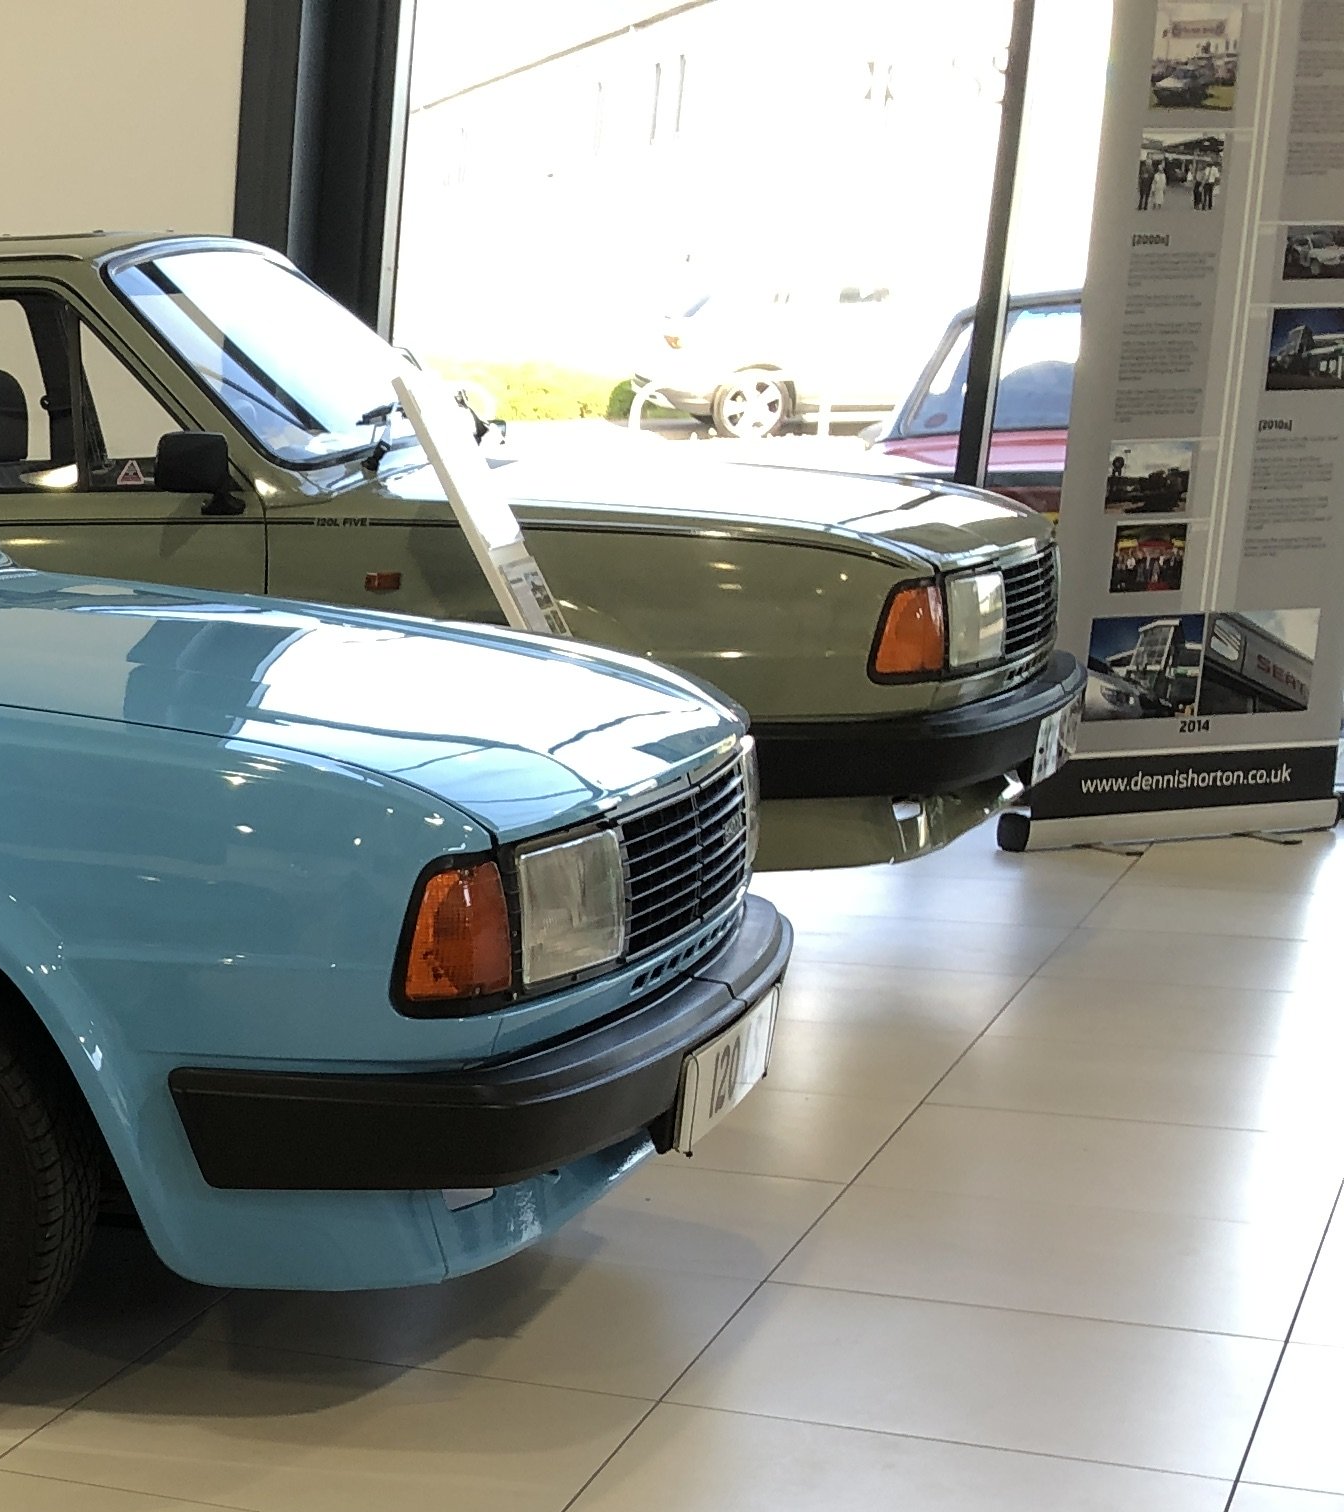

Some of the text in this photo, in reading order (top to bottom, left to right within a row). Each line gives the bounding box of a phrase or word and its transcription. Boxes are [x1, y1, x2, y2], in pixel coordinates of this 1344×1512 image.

[1258, 419, 1293, 432] [2010s]
[1257, 654, 1307, 695] SEAT
[1179, 719, 1210, 733] 2014
[1081, 763, 1292, 794] www.dennishorton.co.uk
[709, 1035, 741, 1119] 120
